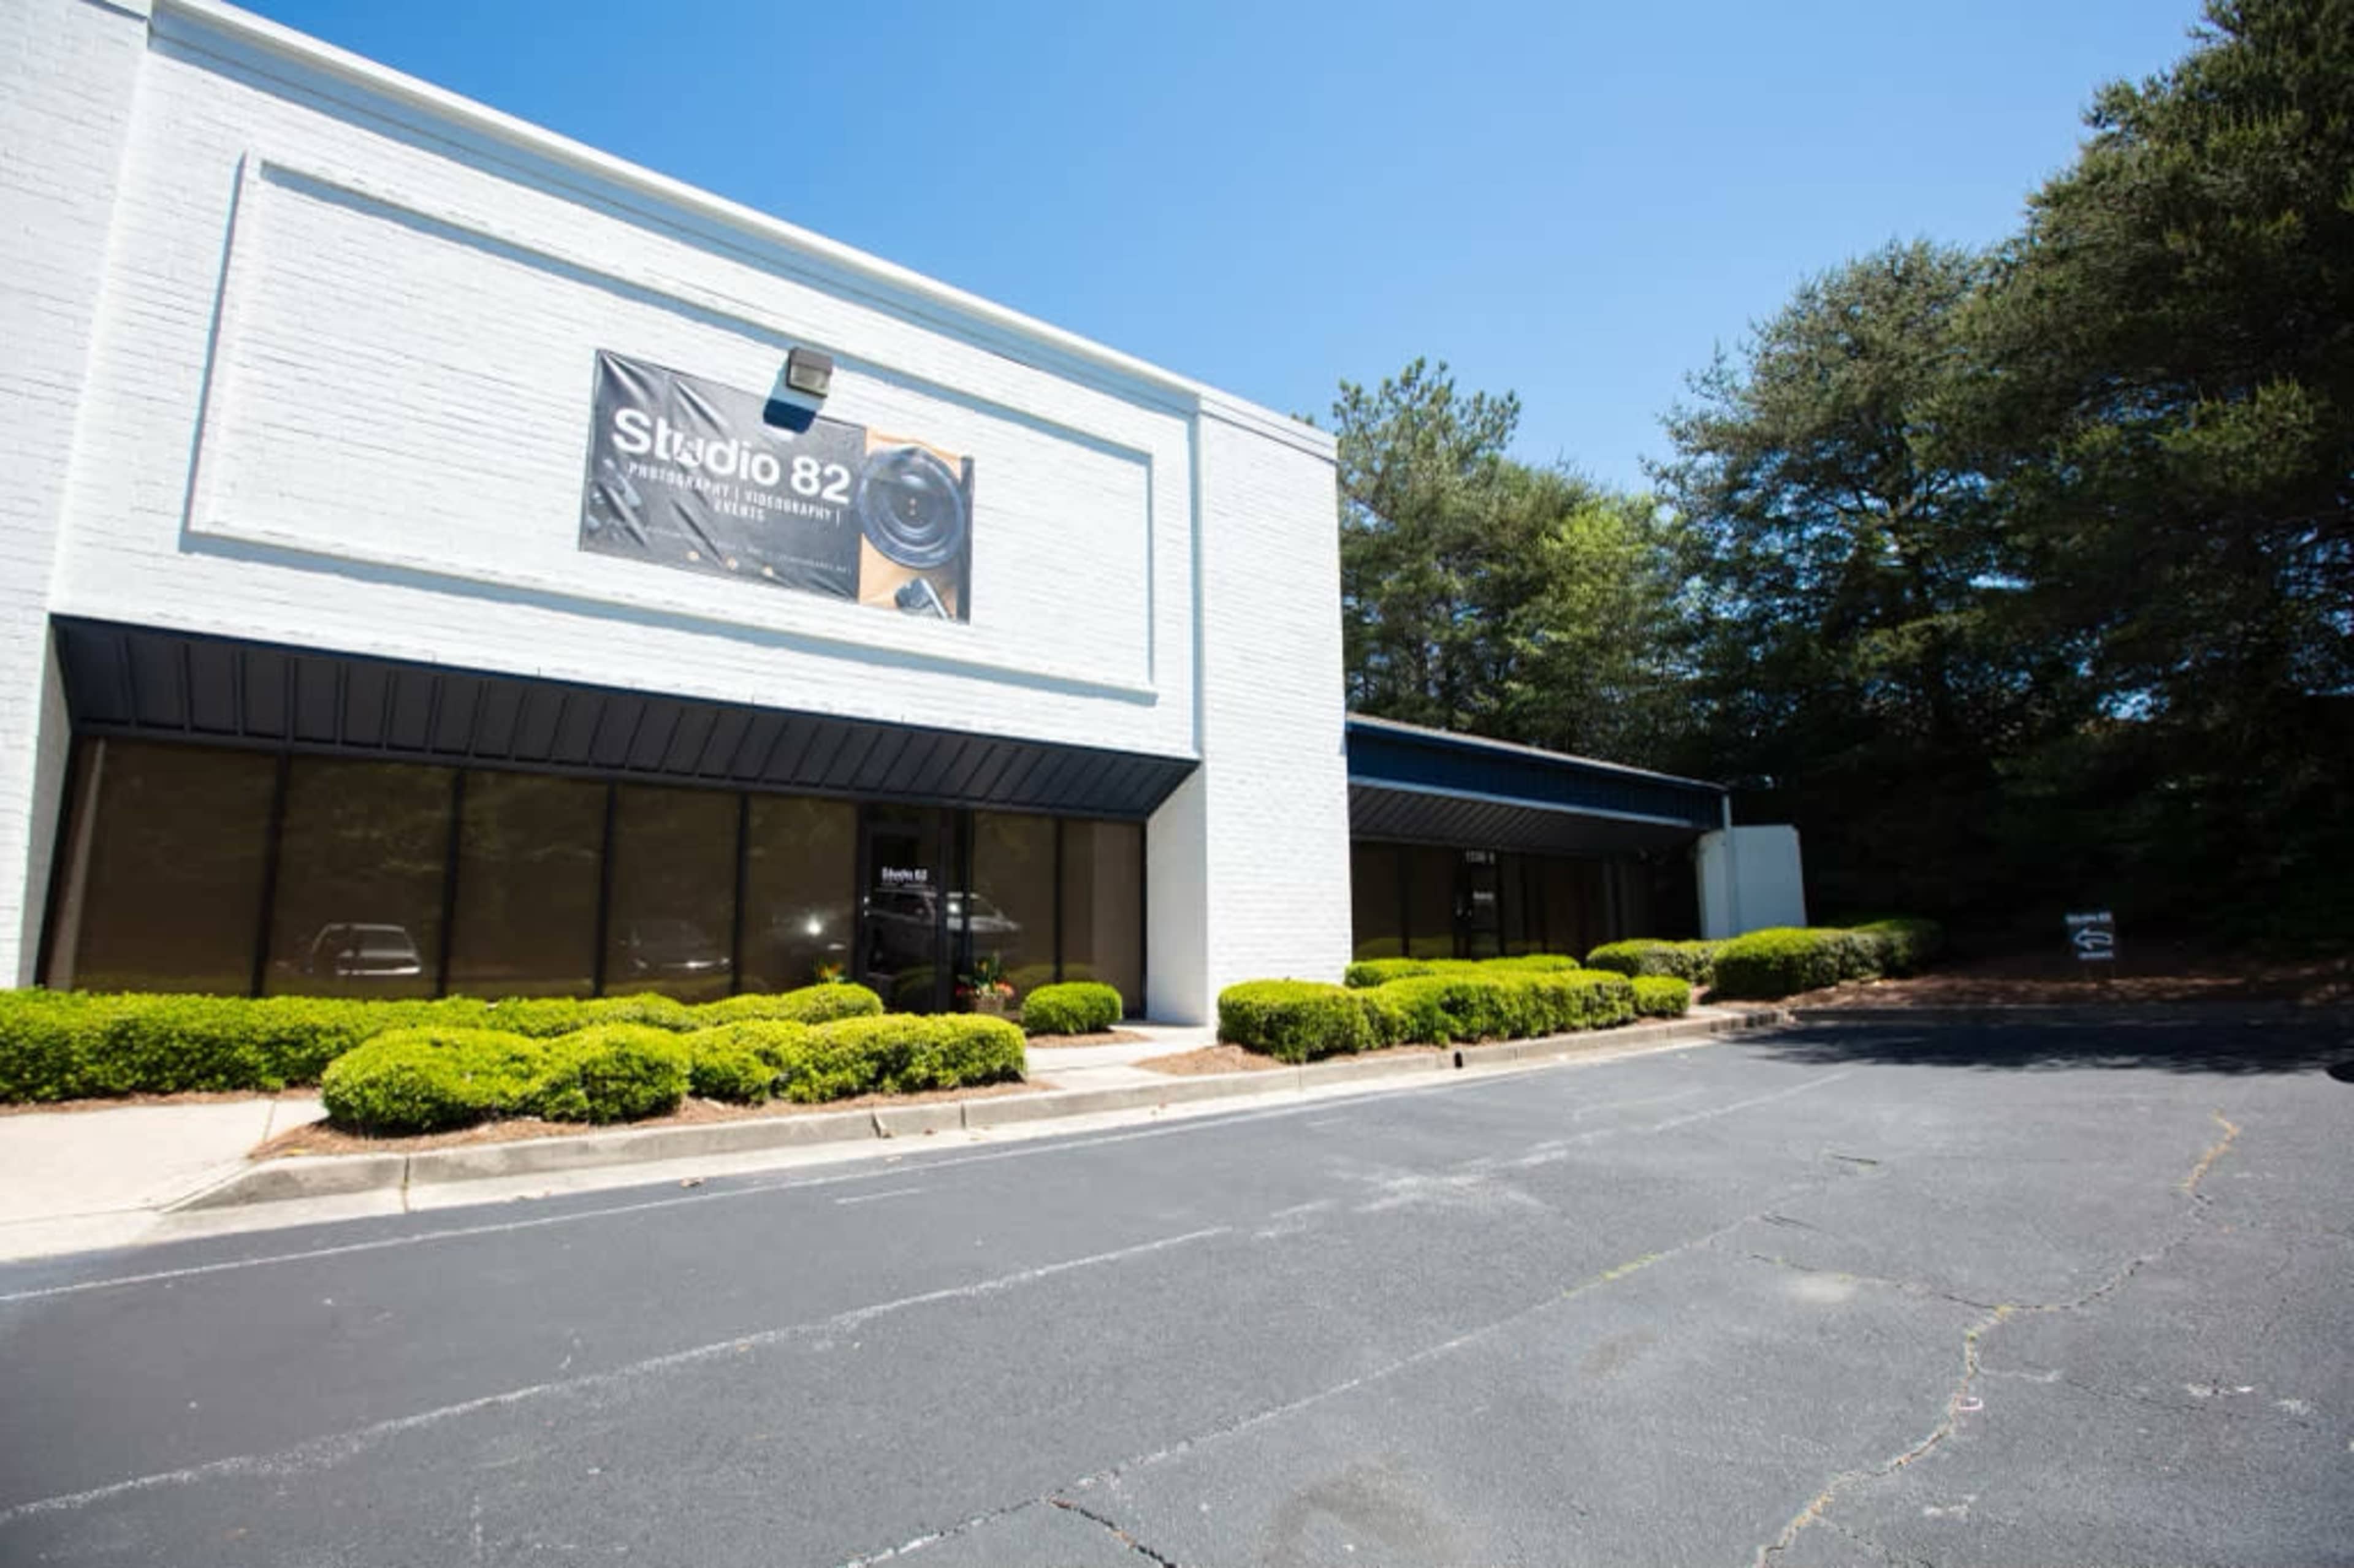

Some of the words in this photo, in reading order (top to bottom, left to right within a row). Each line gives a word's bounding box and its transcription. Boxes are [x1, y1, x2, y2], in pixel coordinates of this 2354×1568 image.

[613, 408, 780, 486] Studio
[791, 455, 851, 504] 82
[629, 462, 730, 497] PHOTOGRAPHY
[744, 490, 831, 520] VIDEOGRAPHY
[714, 499, 765, 522] EVENTS
